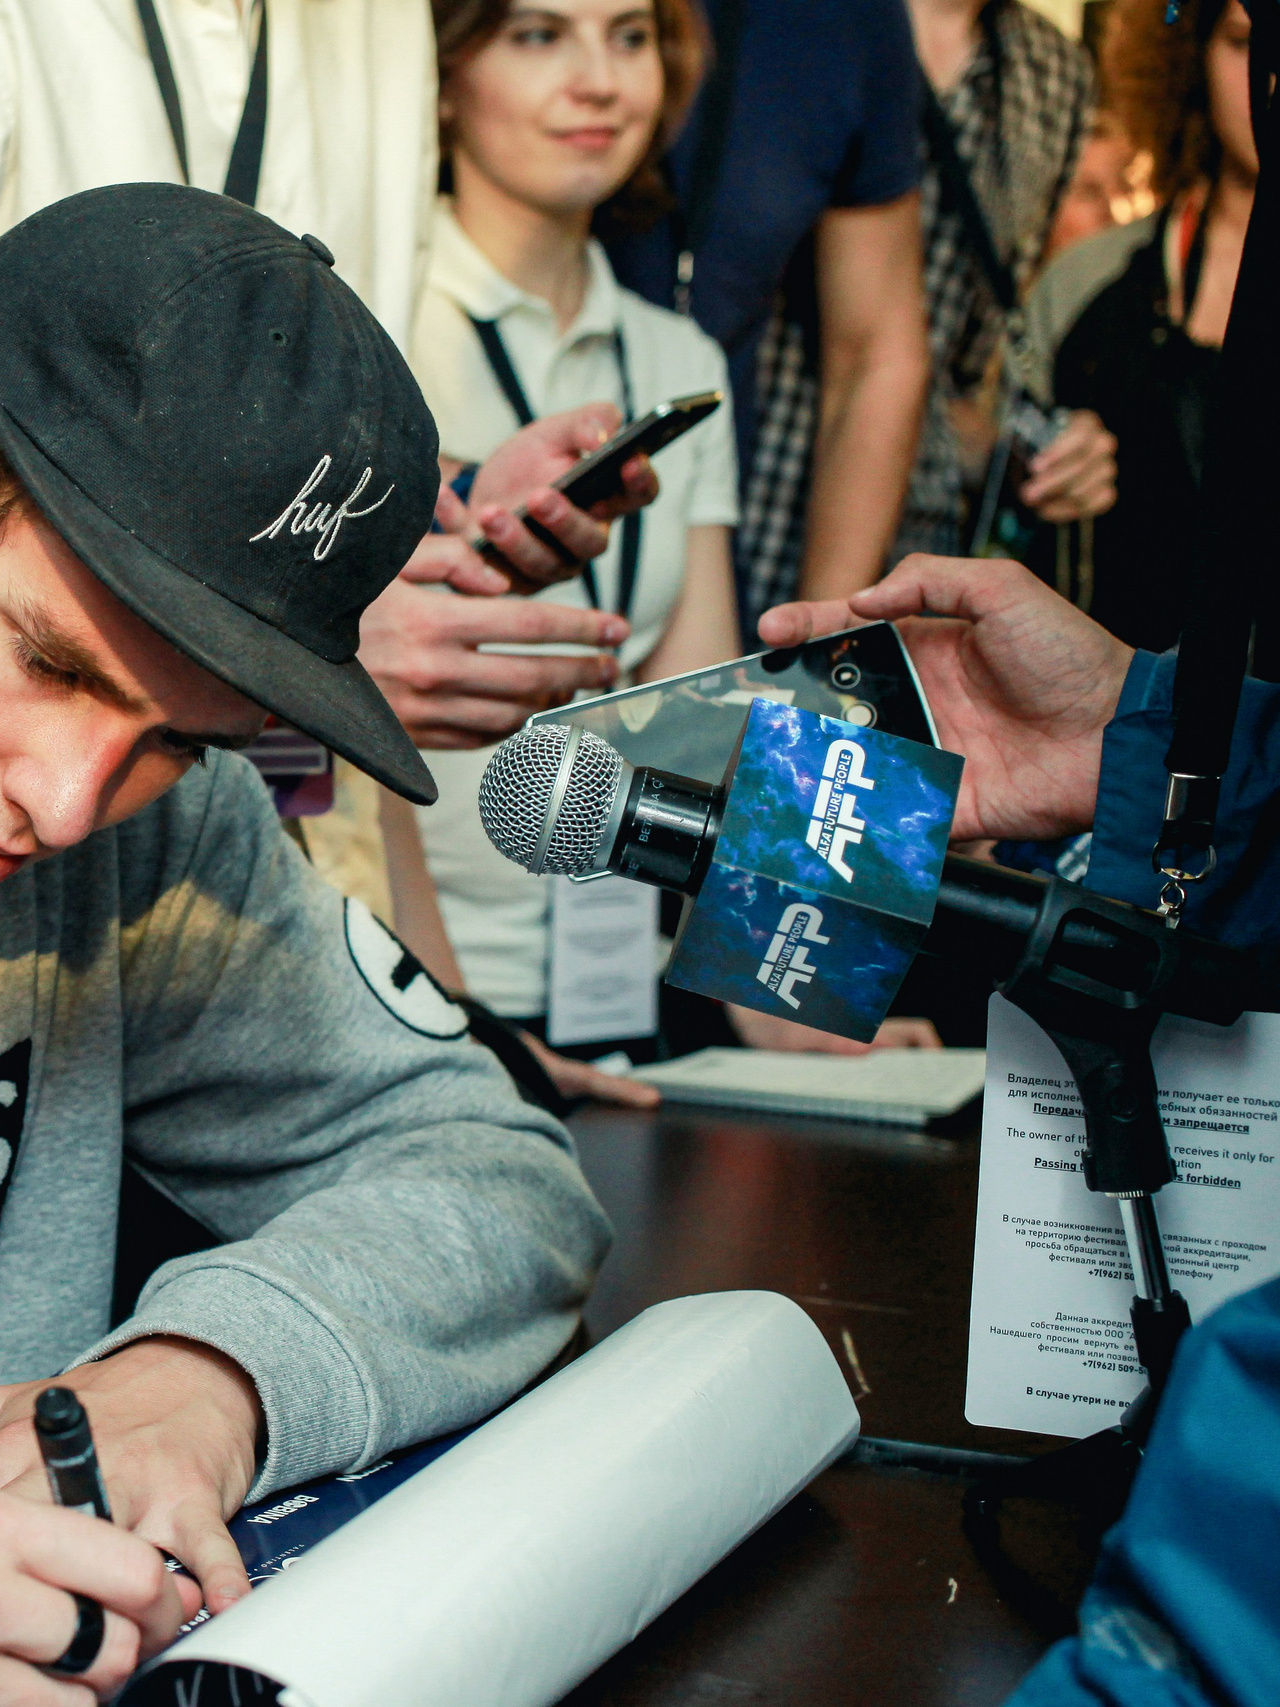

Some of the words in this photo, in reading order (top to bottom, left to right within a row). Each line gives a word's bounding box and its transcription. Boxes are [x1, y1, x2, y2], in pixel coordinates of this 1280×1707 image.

[249, 455, 395, 560] huf
[834, 753, 852, 791] PEOPLE
[805, 739, 875, 883] AFP
[824, 791, 842, 831] FUTURE
[817, 832, 832, 860] ALFA
[756, 902, 830, 1010] AFP
[767, 973, 782, 992] ALFA
[776, 943, 795, 972] FUTURE
[788, 914, 808, 943] PEOPLE
[1008, 1073, 1061, 1088] Владелец
[1173, 1090, 1224, 1102] получает
[1243, 1097, 1280, 1108] только
[1008, 1089, 1027, 1097] для
[1199, 1106, 1278, 1121] обязанностей
[1174, 1118, 1249, 1133] запрещается
[1007, 1127, 1025, 1138] The
[1029, 1131, 1062, 1141] owner
[1065, 1134, 1075, 1143] of
[1174, 1146, 1219, 1158] receives
[1222, 1149, 1230, 1158] it
[1233, 1152, 1256, 1164] only
[1259, 1153, 1275, 1163] for
[1034, 1158, 1076, 1172] Passing
[1186, 1173, 1241, 1188] forbidden
[1176, 1159, 1201, 1169] ution
[1011, 1217, 1041, 1226] случае
[1043, 1221, 1112, 1234] возникновения
[1162, 1233, 1212, 1245] связанных
[1222, 1240, 1266, 1251] проходом
[1028, 1229, 1081, 1241] территорию
[1084, 1235, 1127, 1246] фестивал
[1183, 1248, 1251, 1261] аккредитации,
[1025, 1240, 1061, 1250] просьба
[1064, 1244, 1117, 1256] обращаться
[1168, 1257, 1210, 1267] ционный
[1212, 1262, 1239, 1272] центр
[1049, 1253, 1096, 1265] фестиваля
[1170, 1268, 1214, 1280] телефону
[1089, 1269, 1122, 1280] +7(962)
[1031, 1321, 1102, 1336] собственностью
[1055, 1312, 1089, 1323] Данная
[1091, 1316, 1133, 1328] аккредит
[990, 1326, 1041, 1339] Нашедшего
[1046, 1334, 1079, 1344] просим
[1084, 1339, 1119, 1350] вернуть
[1037, 1343, 1085, 1356] фестиваля
[1087, 1350, 1104, 1358] или
[1107, 1353, 1138, 1362] позвон
[1082, 1360, 1115, 1371] +7(962)
[1118, 1364, 1147, 1375] 509-5
[1036, 1389, 1070, 1400] случае
[1072, 1394, 1101, 1405] утери
[1103, 1399, 1116, 1407] не
[247, 1494, 320, 1524] BOBINA
